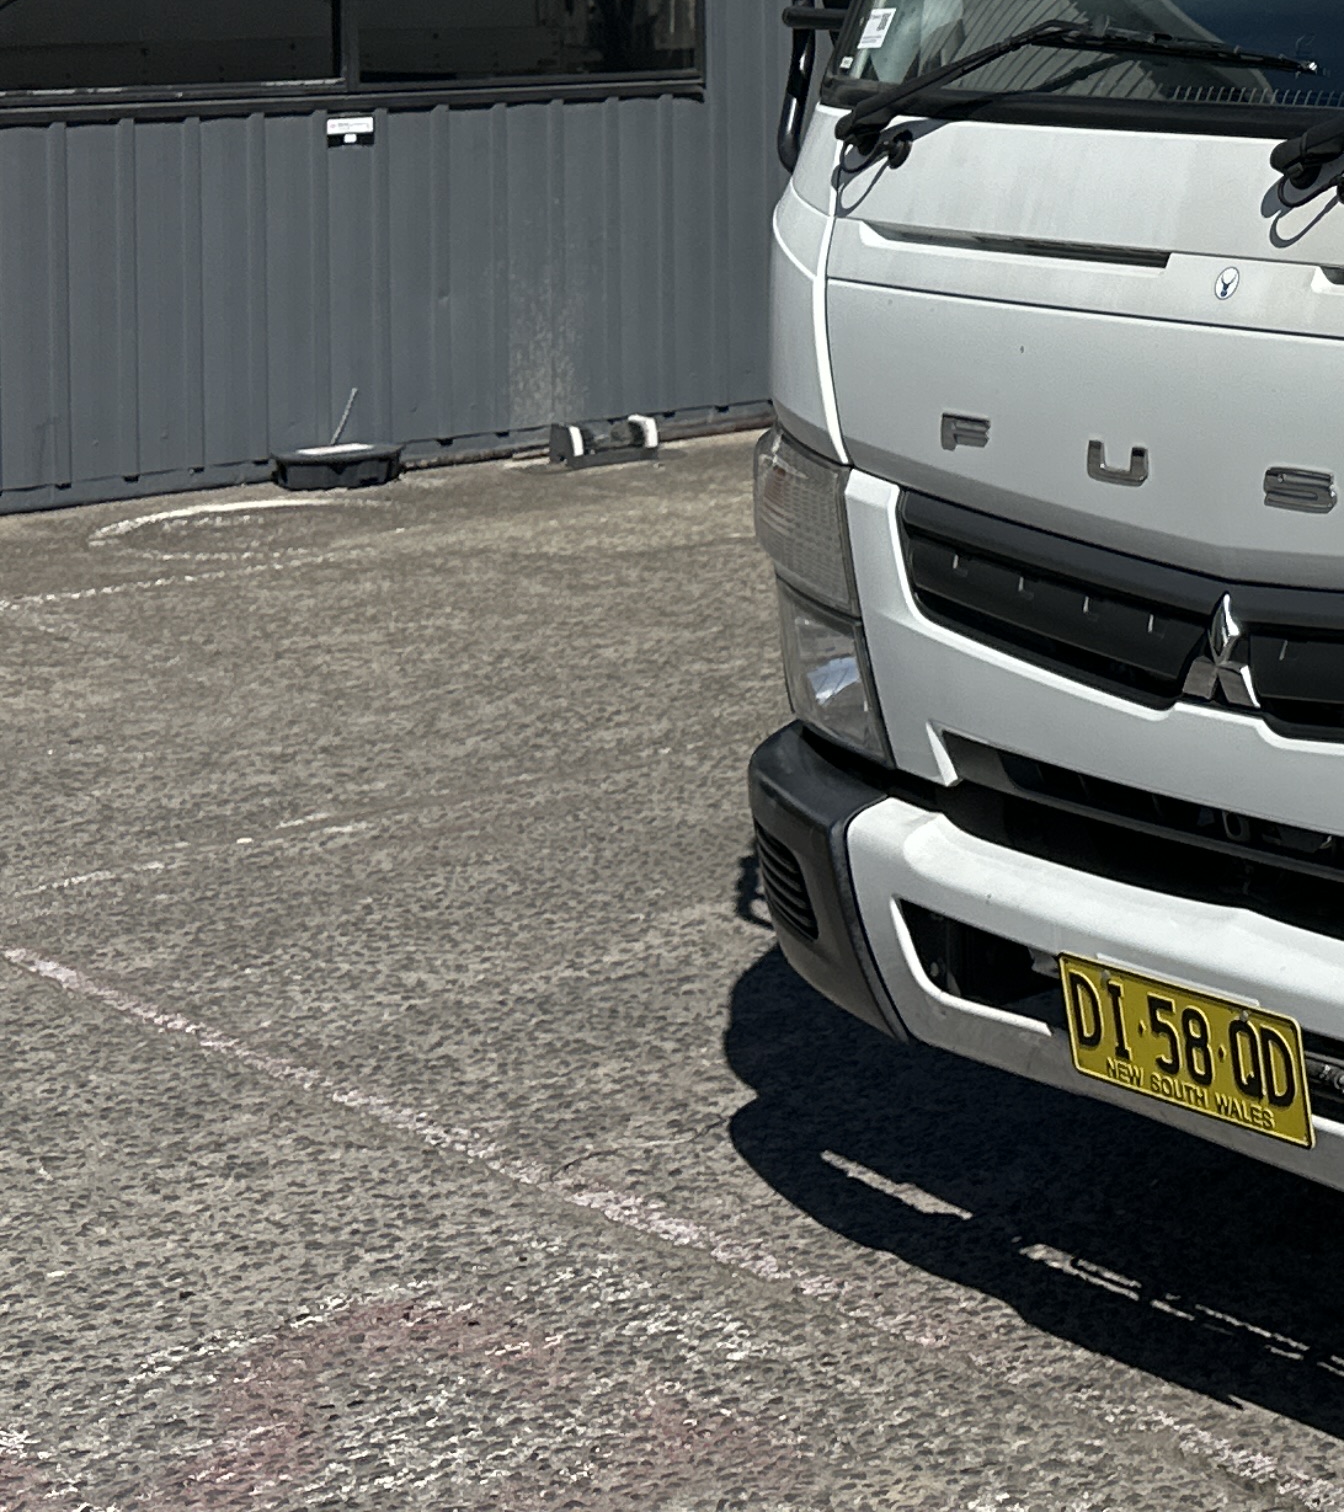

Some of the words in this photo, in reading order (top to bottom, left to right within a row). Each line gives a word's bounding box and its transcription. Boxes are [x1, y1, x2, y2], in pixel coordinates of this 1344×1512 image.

[1106, 1056, 1145, 1087] NEW
[1150, 1072, 1209, 1110] SOUTH
[1215, 1090, 1276, 1130] WALES
